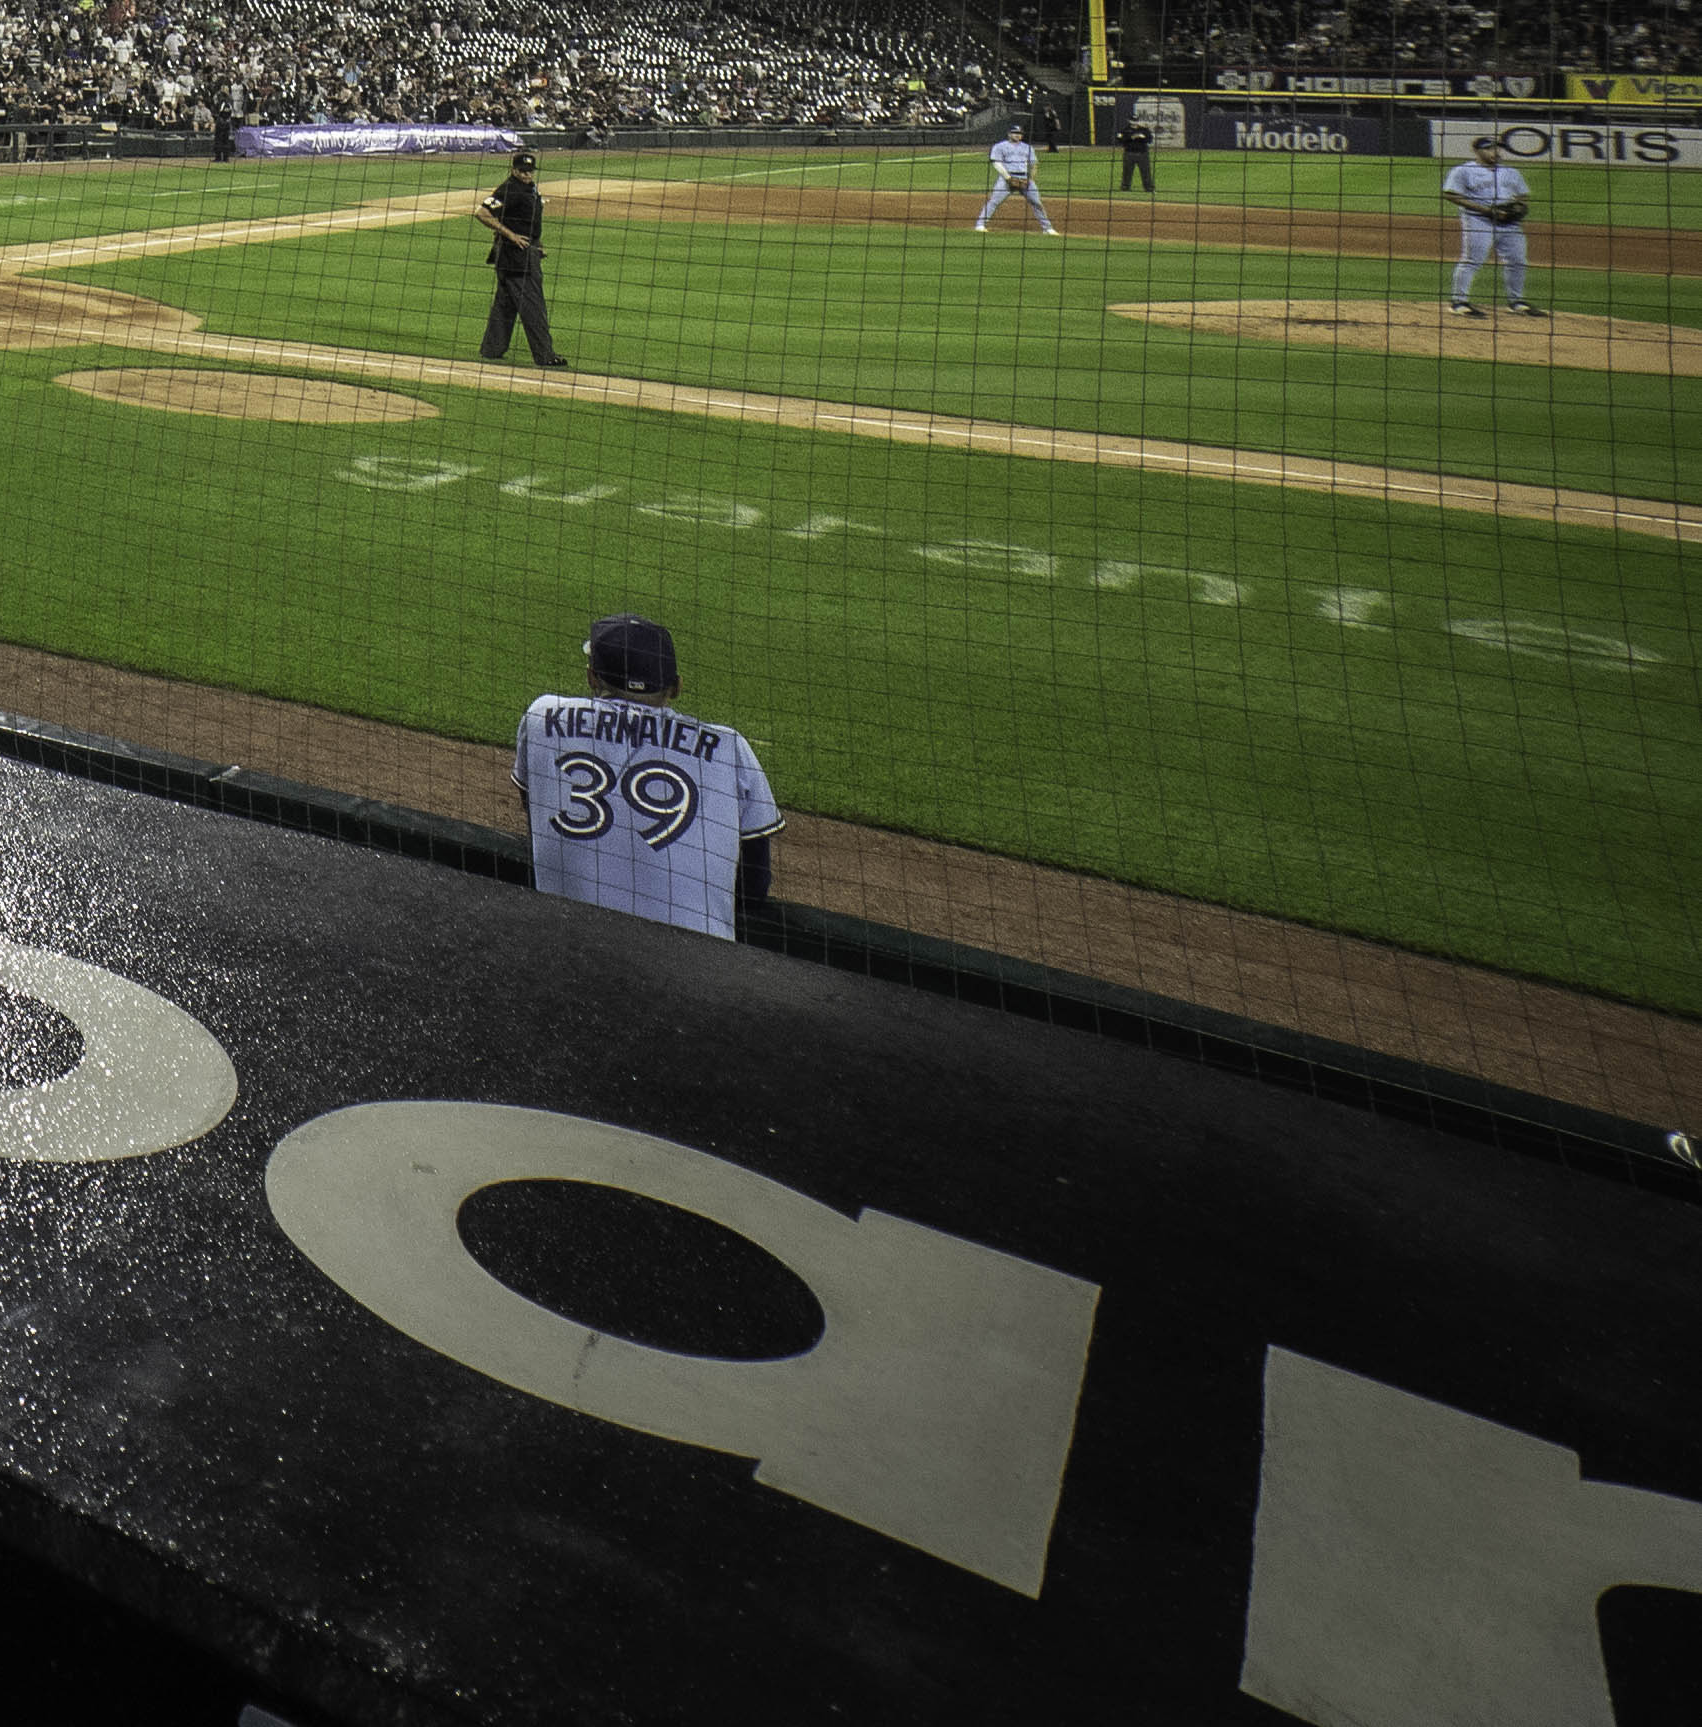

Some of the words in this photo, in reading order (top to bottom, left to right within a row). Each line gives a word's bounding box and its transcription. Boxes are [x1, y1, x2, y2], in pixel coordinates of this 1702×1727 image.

[1235, 121, 1348, 153] Modelo
[1501, 125, 1680, 163] ORIS
[545, 706, 721, 763] KIERMAIER
[549, 751, 700, 853] 39
